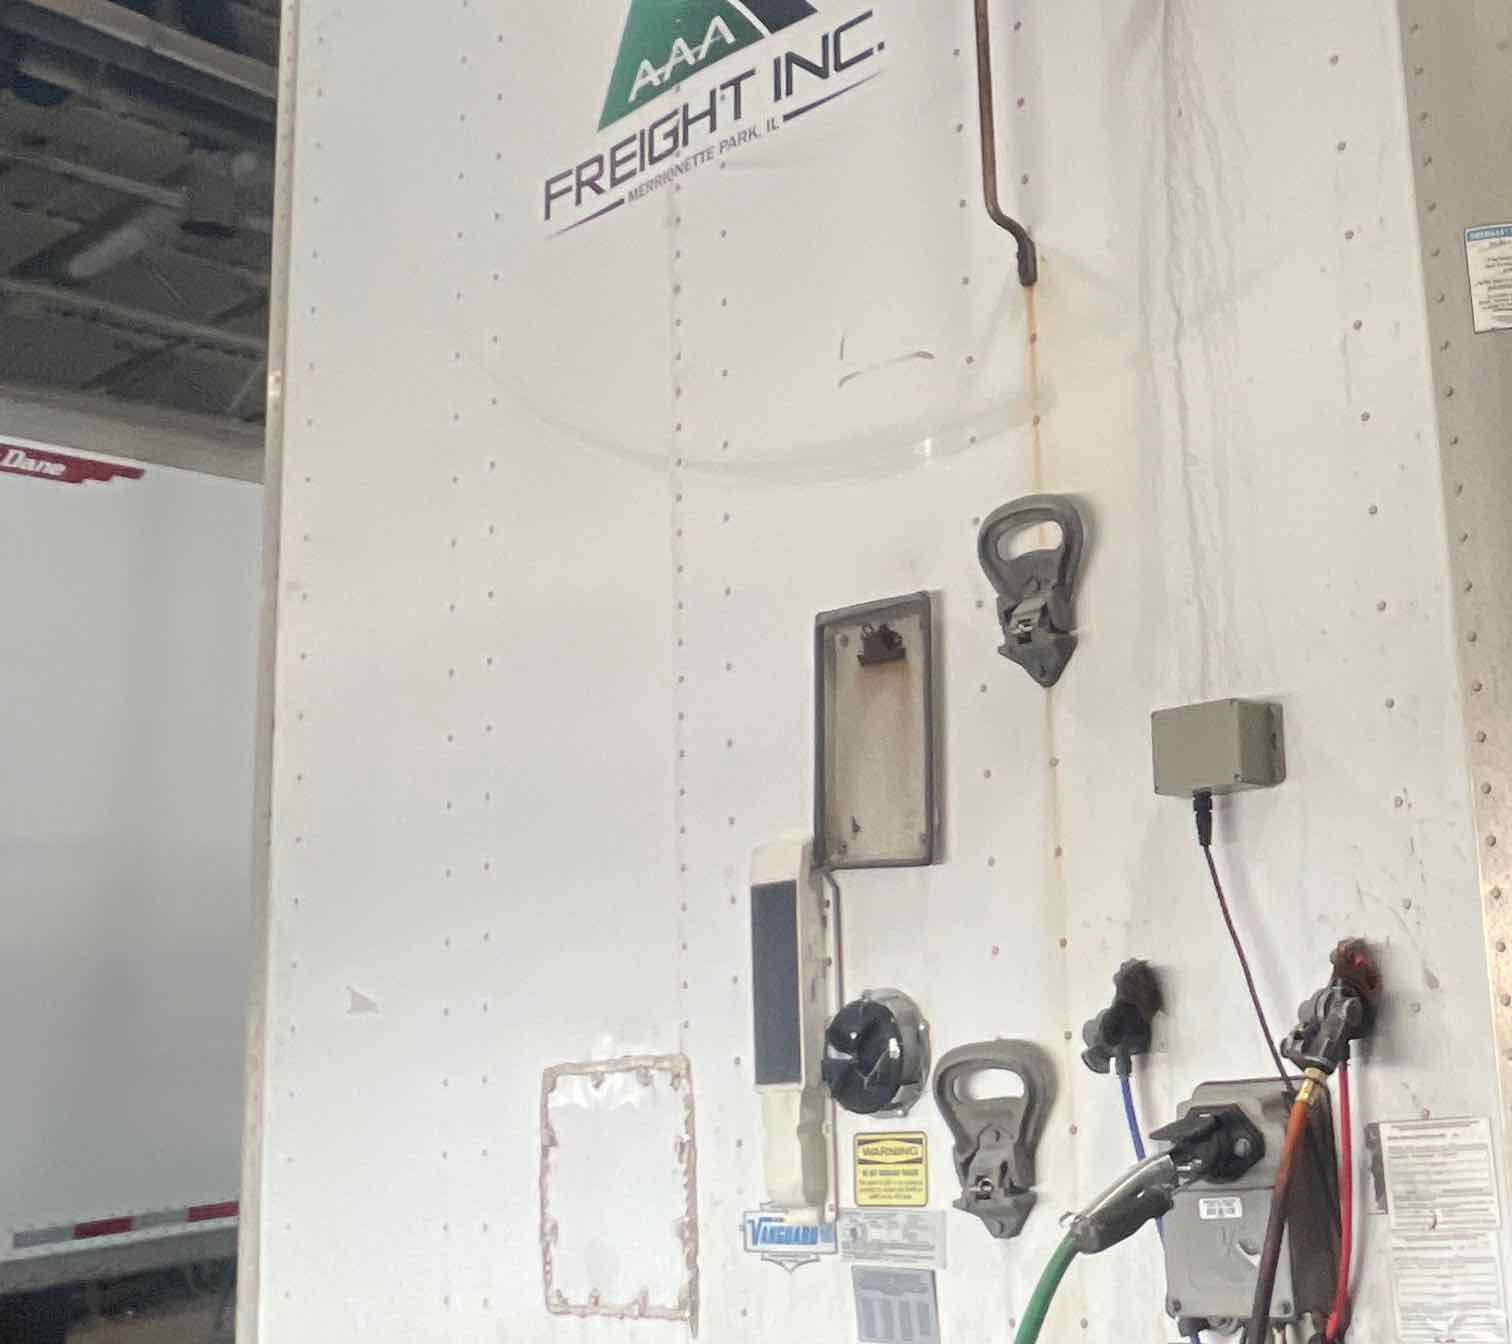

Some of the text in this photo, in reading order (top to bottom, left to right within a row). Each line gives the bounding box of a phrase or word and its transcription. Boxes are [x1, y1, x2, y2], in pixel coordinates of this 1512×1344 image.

[628, 15, 736, 103] AAA
[544, 9, 886, 220] FREIGHT INC.
[1, 449, 67, 476] Dane
[862, 1145, 919, 1156] WARNING
[748, 1217, 819, 1246] VANGUARD
